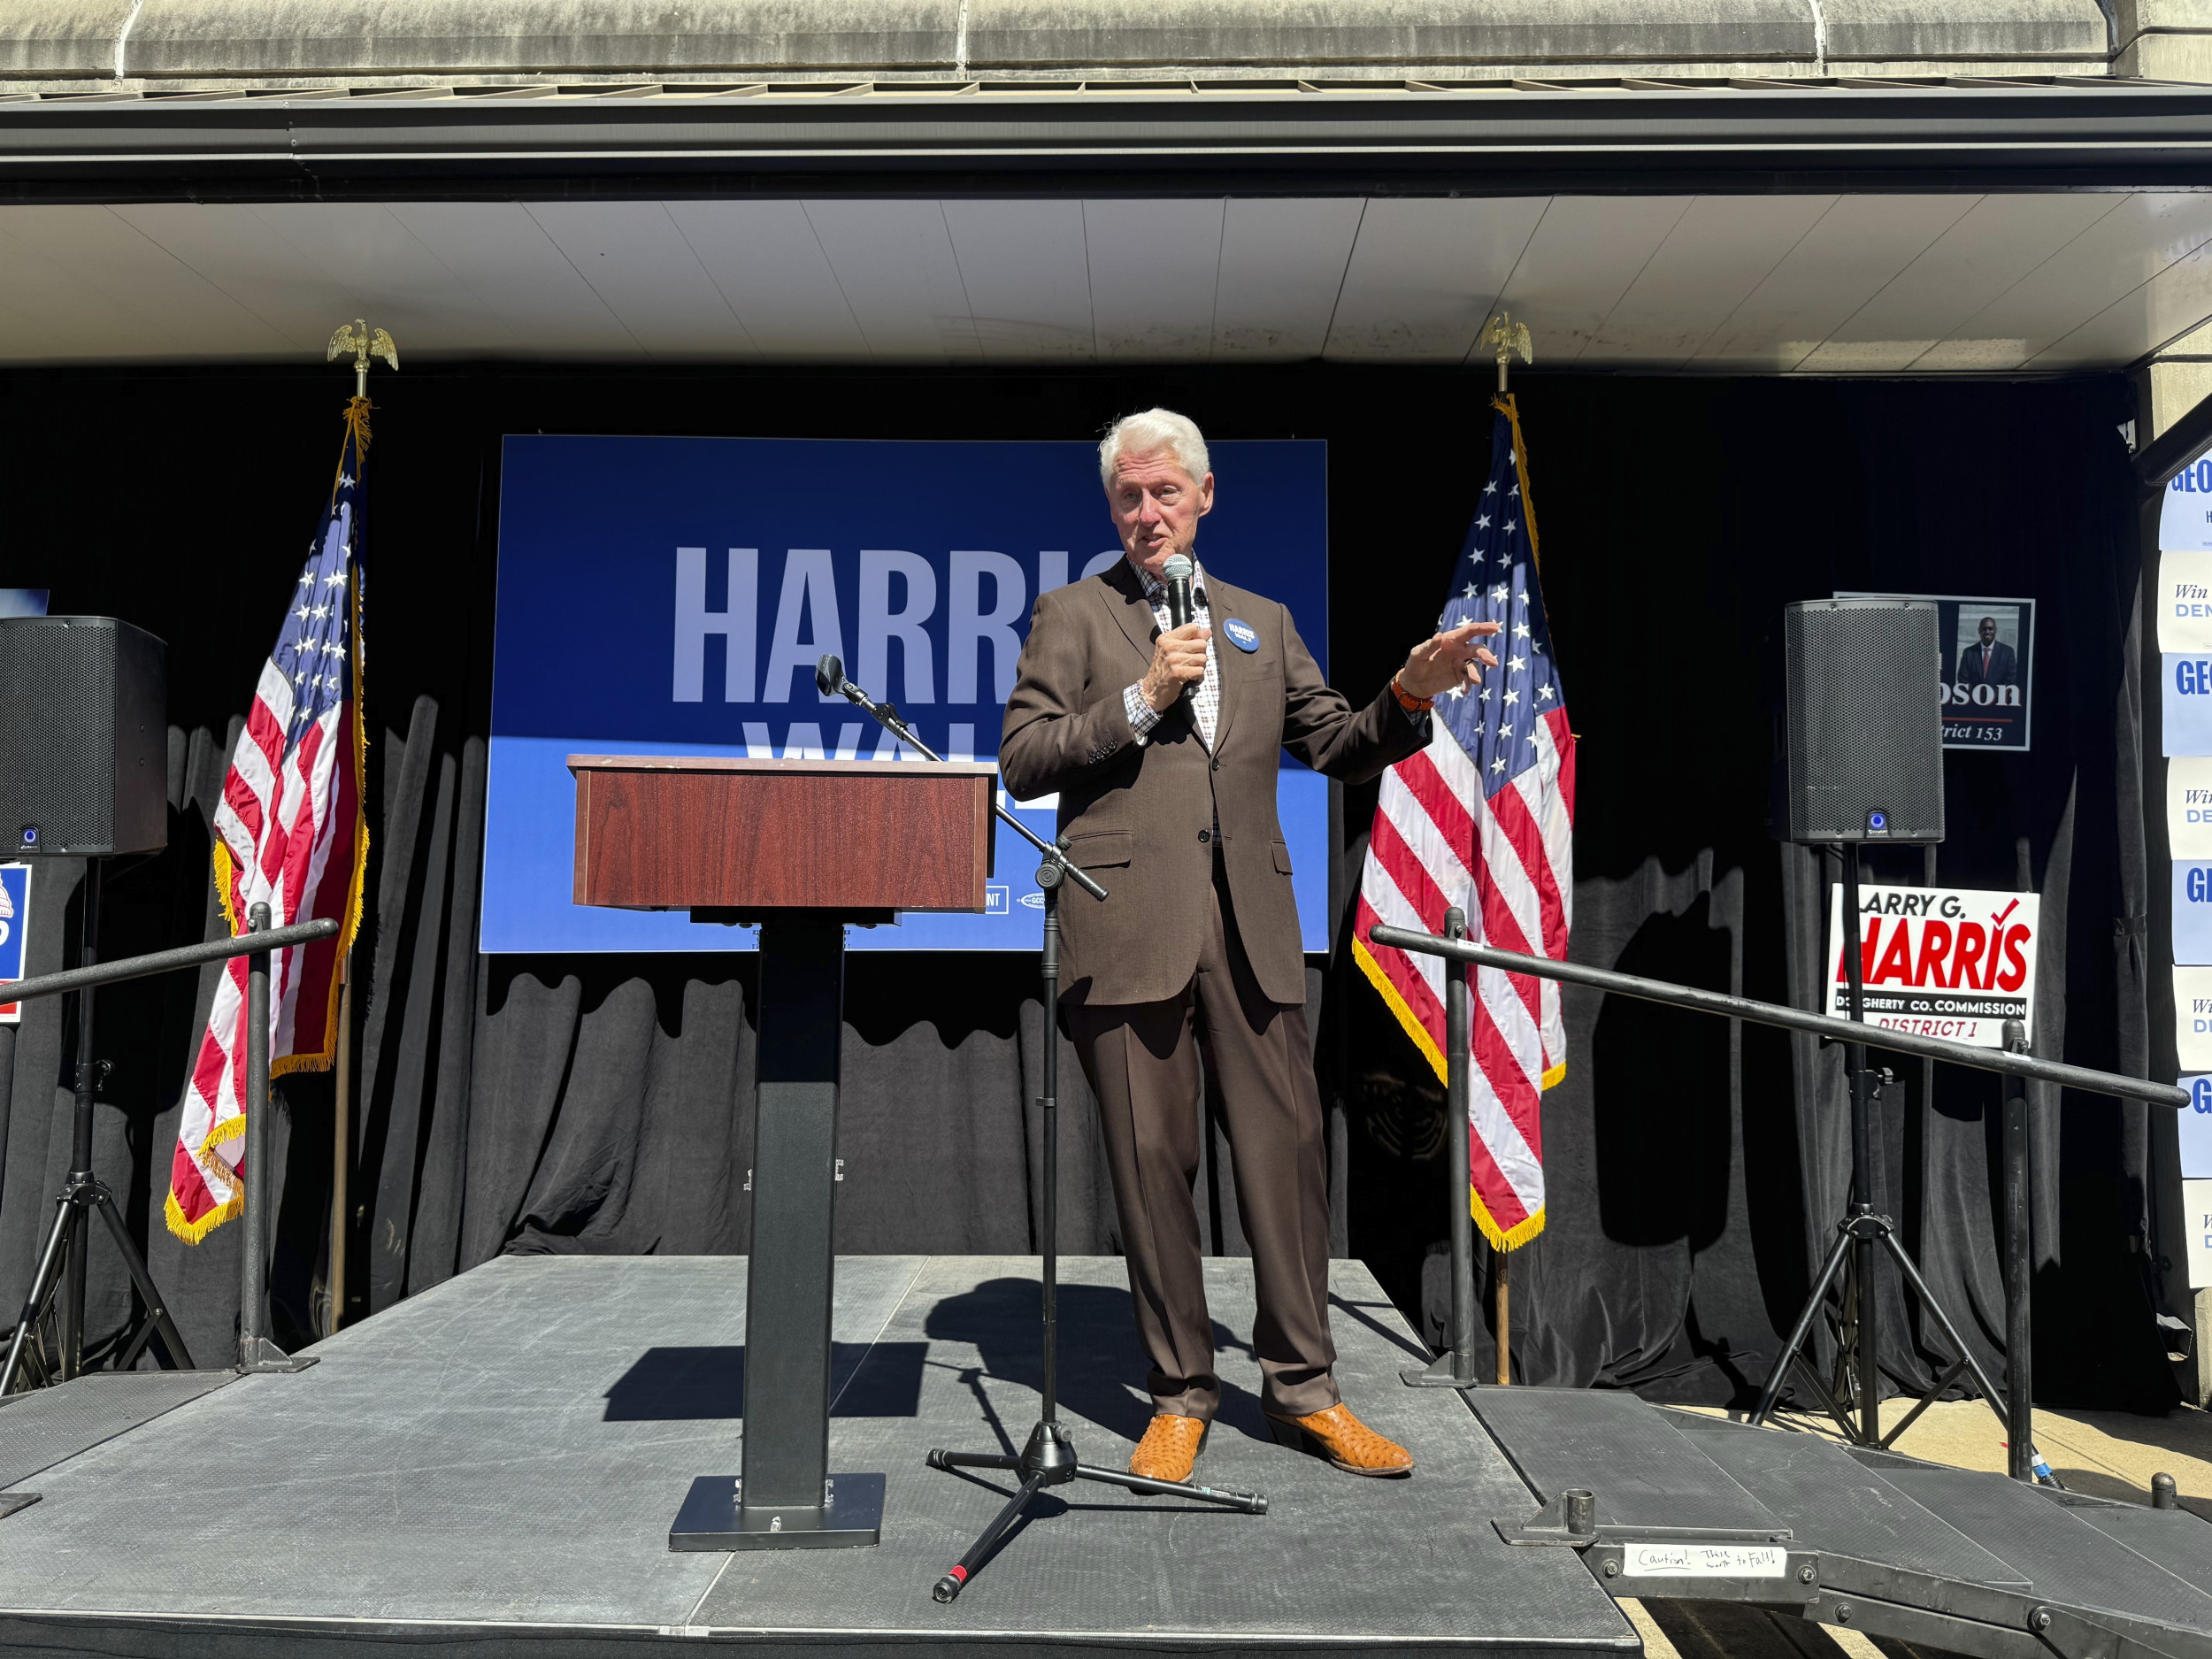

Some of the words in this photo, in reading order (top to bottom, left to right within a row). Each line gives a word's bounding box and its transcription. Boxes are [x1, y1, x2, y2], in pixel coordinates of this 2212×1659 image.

[2176, 584, 2208, 598] Win
[672, 547, 1126, 703] HARR
[1228, 623, 1255, 640] HARRIS
[1234, 632, 1253, 643] WALZ
[1976, 727, 2002, 741] 153
[1940, 896, 1966, 918] G.
[1910, 1001, 1932, 1012] CO.
[1935, 1000, 2025, 1015] COMMISSION
[1969, 1022, 1977, 1037] 1
[1639, 1548, 1691, 1565] Caution!
[1737, 1555, 1747, 1566] to
[1748, 1550, 1776, 1568] Fall!
